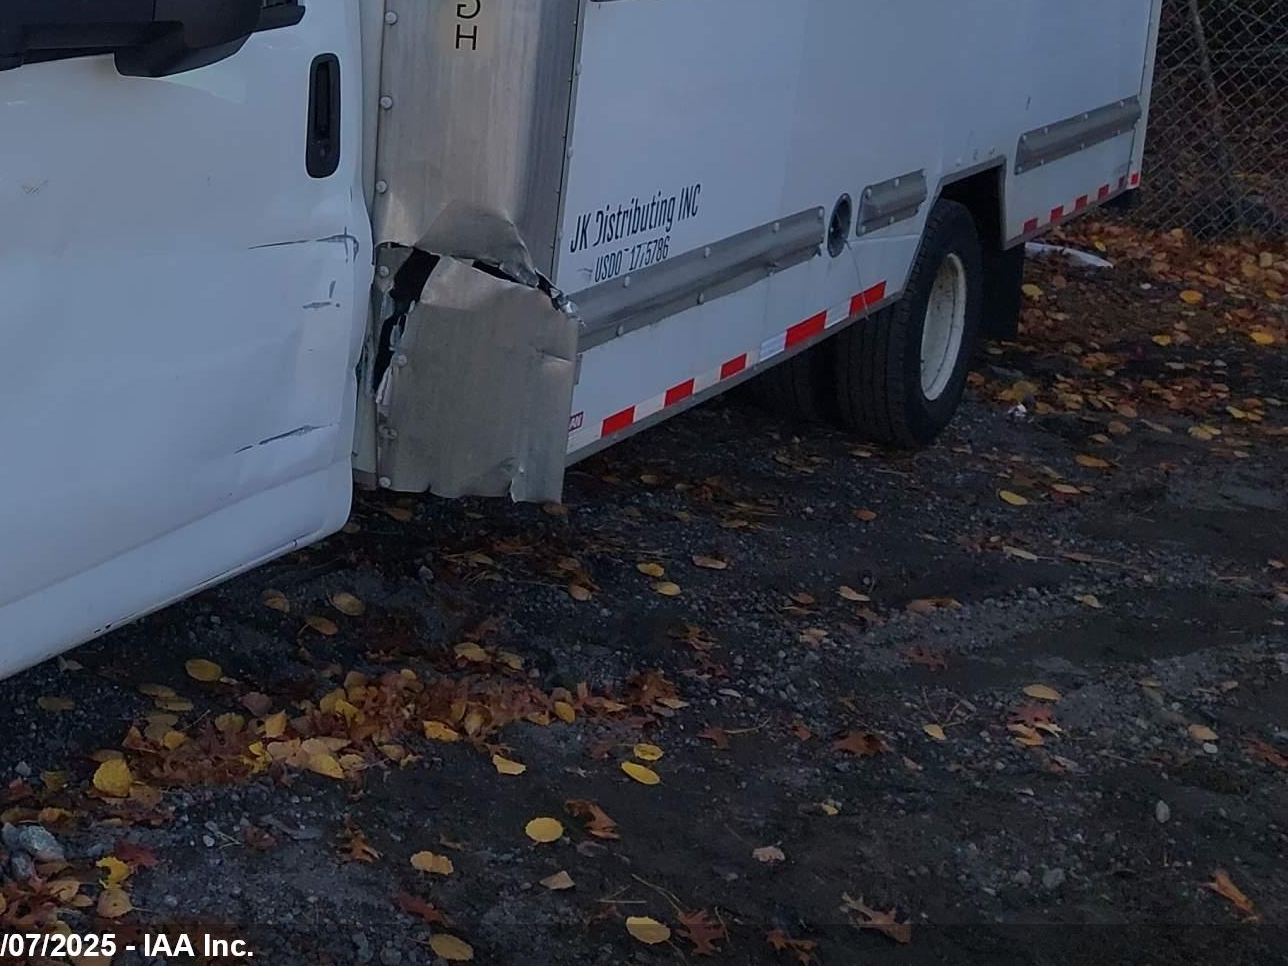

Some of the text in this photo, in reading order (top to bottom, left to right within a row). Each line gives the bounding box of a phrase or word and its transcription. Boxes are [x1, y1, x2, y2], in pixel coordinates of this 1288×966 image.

[570, 183, 701, 253] JK Distributing INC
[594, 247, 630, 283] USDO
